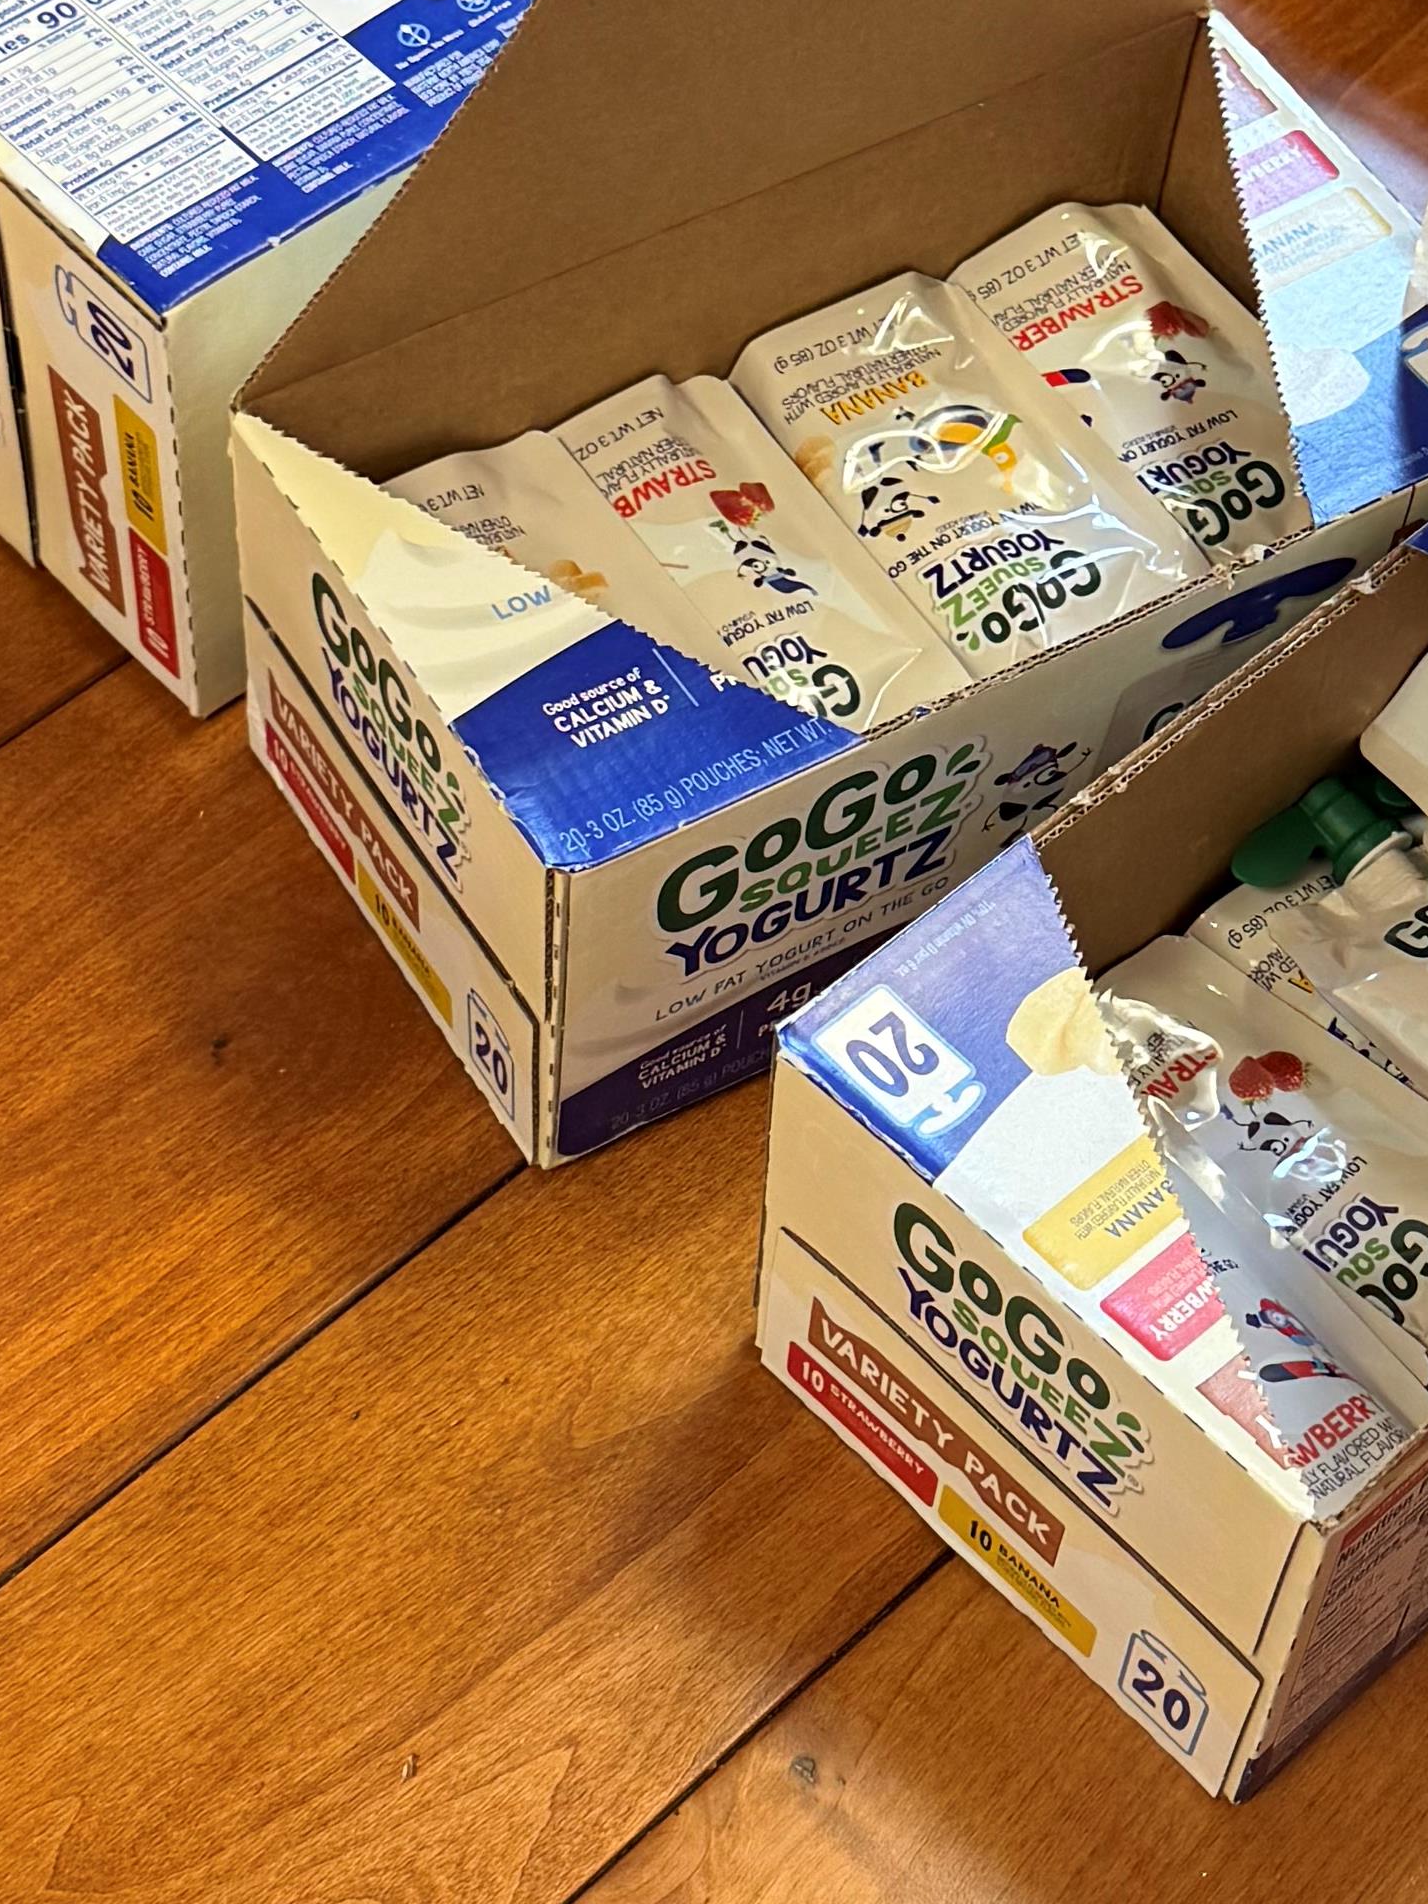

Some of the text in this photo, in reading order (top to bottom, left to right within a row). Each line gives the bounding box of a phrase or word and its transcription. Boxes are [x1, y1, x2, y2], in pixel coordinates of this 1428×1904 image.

[36, 1, 78, 29] 90
[86, 299, 136, 381] 20
[819, 338, 839, 358] OZ
[819, 370, 929, 426] BANANA
[1207, 409, 1239, 429] LOW
[62, 388, 113, 593] VARIETY PACK
[133, 490, 155, 523] 10
[887, 562, 909, 579] GO
[922, 529, 1065, 599] YOGURTZ
[490, 584, 552, 621] LOW
[147, 625, 170, 659] 10
[310, 569, 442, 776] GoGo
[542, 666, 643, 717] Good source of
[552, 678, 663, 733] CALCIUM &
[569, 706, 650, 749] VITAMIN
[271, 737, 291, 773] 10
[320, 644, 463, 882] YOGURTZ
[350, 669, 467, 837] SQUEEZ
[558, 718, 833, 858] 20-3 OZ. (85 g) POUCHES; NET WT.
[272, 687, 416, 912] VARIETY PACK
[656, 752, 938, 935] GoGo
[738, 780, 969, 915] SQUEEZ
[372, 890, 392, 927] 10
[665, 824, 953, 979] YOGURTZ
[654, 876, 950, 1024] LOW FAT YOGURT ON THE GO
[766, 978, 814, 1014] 4g
[473, 1020, 508, 1093] 20
[637, 1041, 712, 1082] CALCIUM
[641, 1055, 709, 1091] VITAMIN
[844, 1011, 941, 1099] 20
[892, 1201, 1112, 1412] GoGo
[800, 1361, 927, 1478] 10 STRAWBERRY
[896, 1266, 1120, 1509] YOGURTZ
[951, 1297, 1133, 1480] SQUEEZ
[818, 1315, 1052, 1547] VARIETY PACK
[968, 1518, 1063, 1610] 10 BANANA
[1131, 1657, 1191, 1731] 20
